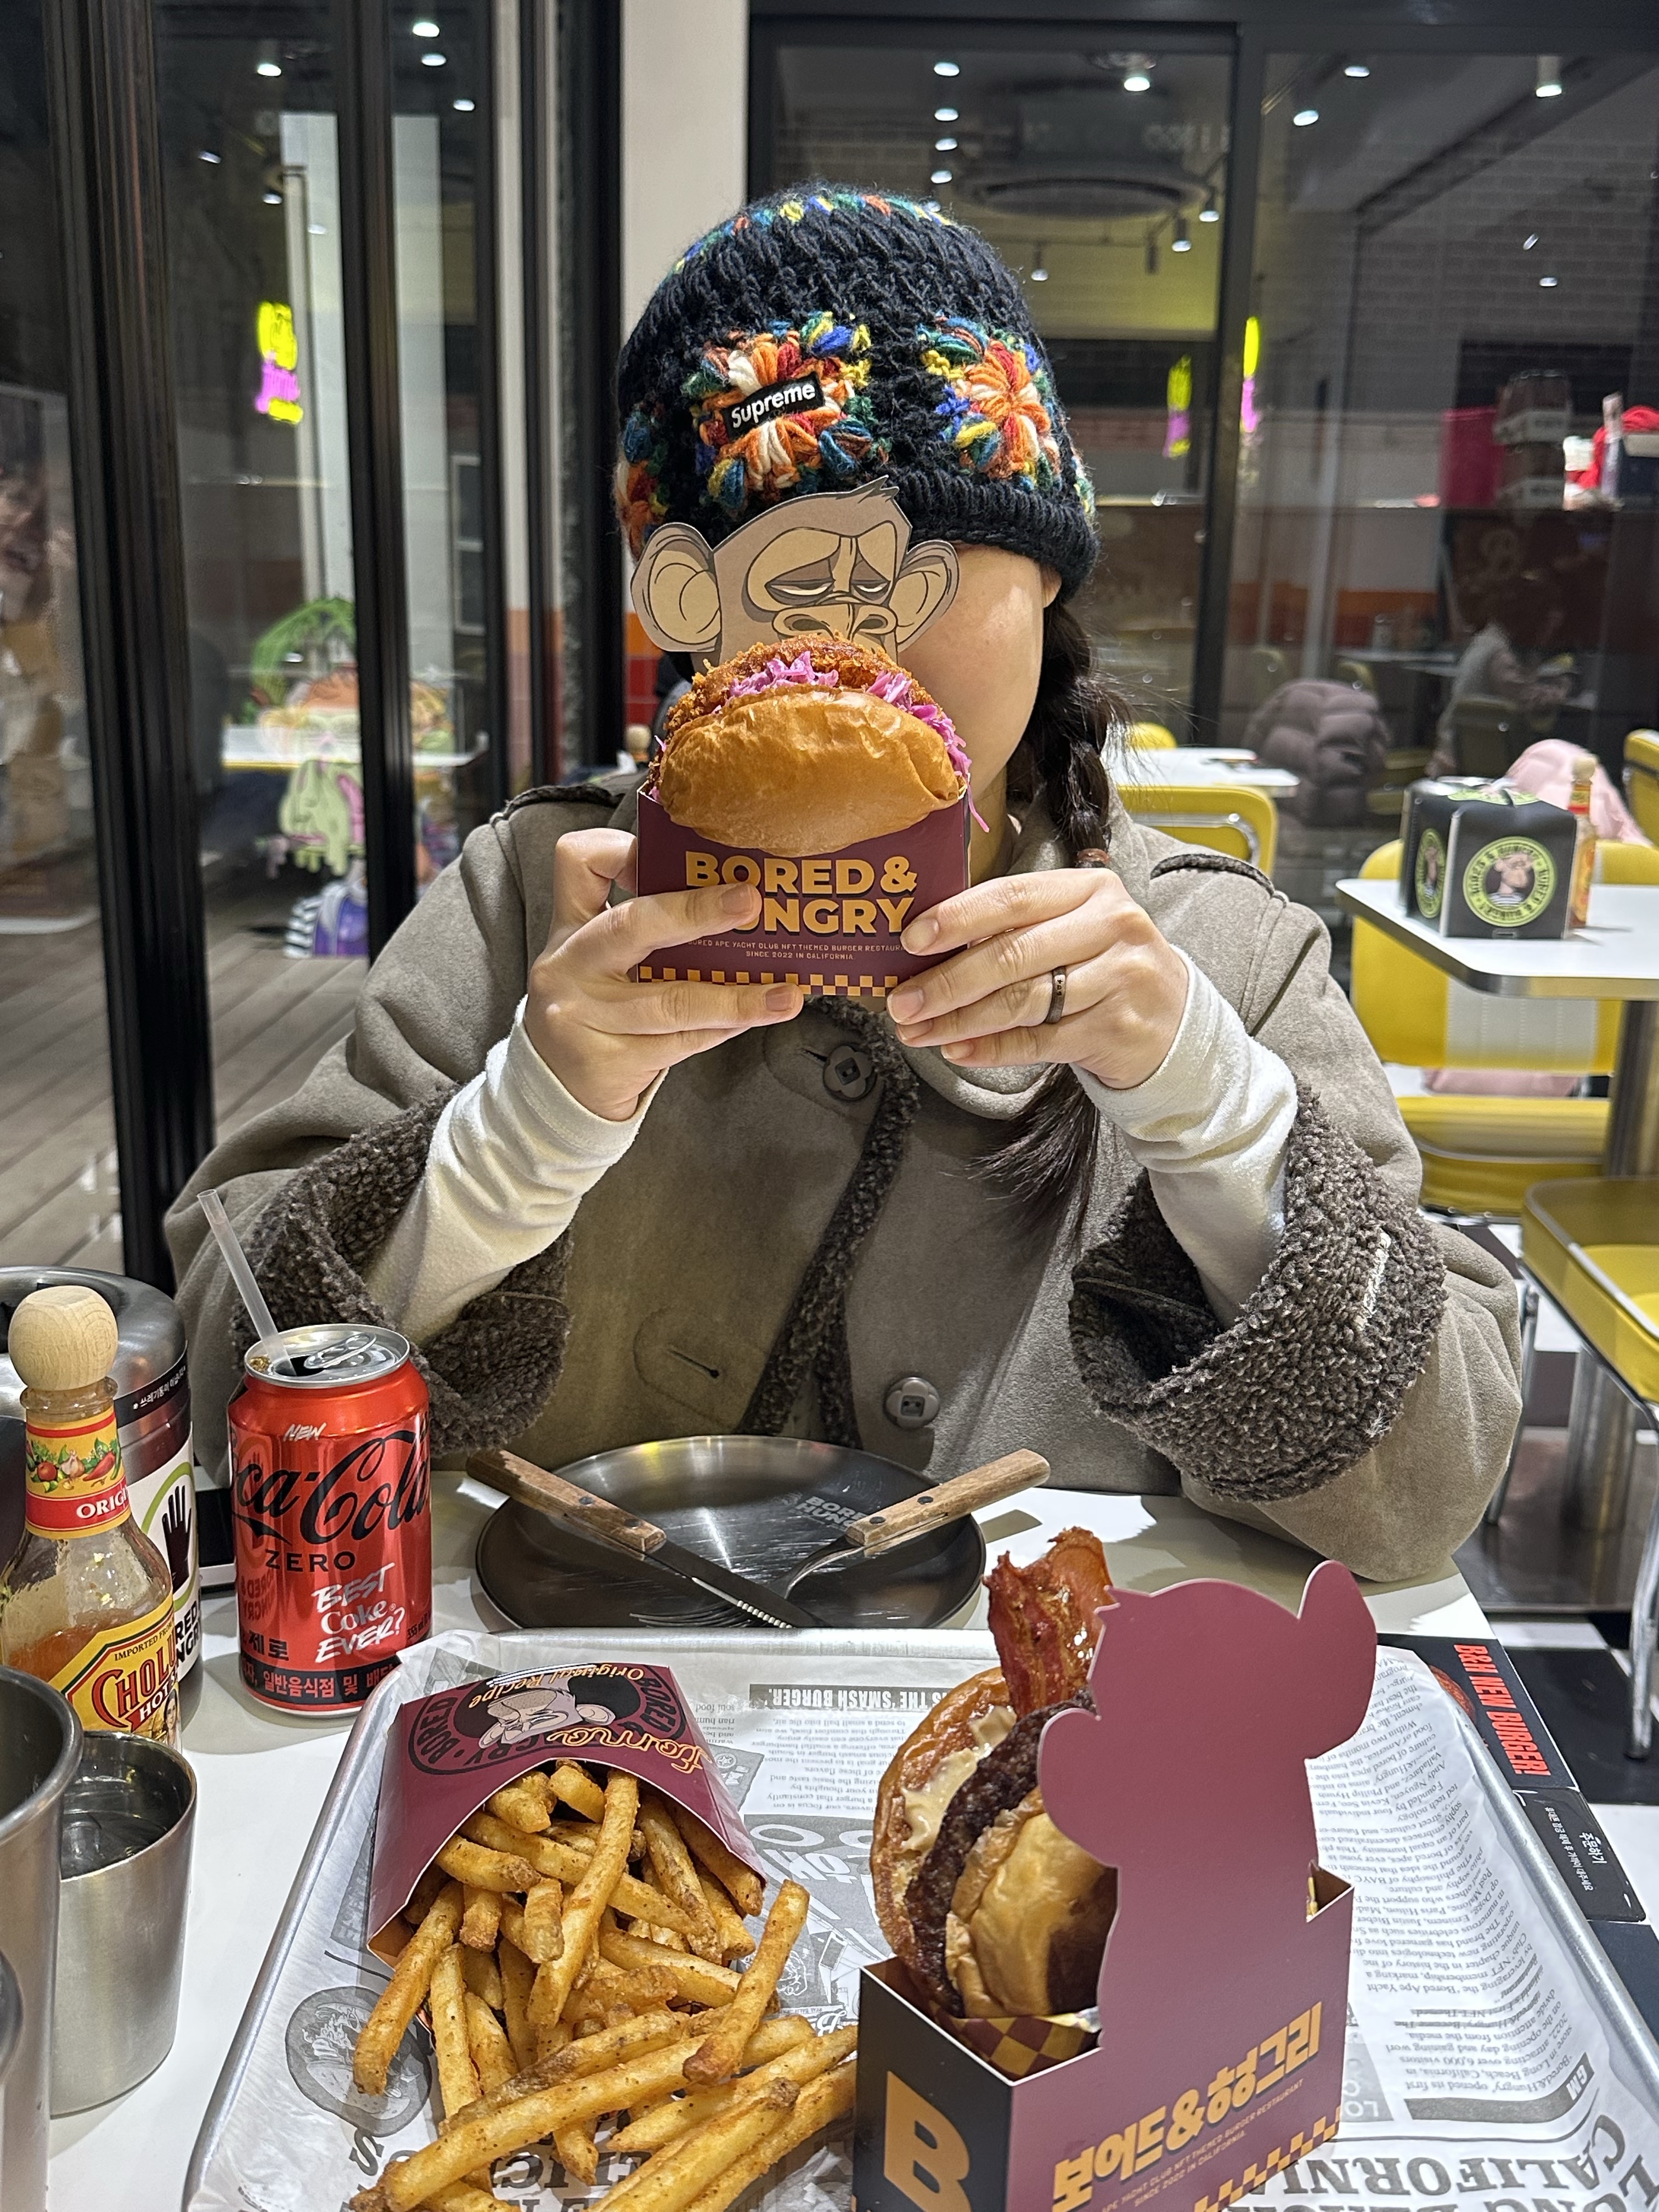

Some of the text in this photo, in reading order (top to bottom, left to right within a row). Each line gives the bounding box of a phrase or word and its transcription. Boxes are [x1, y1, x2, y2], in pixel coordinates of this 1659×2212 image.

[730, 383, 816, 428] Supreme
[685, 851, 918, 895] BORED &
[734, 897, 915, 934] NGRY
[283, 1422, 326, 1442] NEW
[265, 1549, 356, 1573] ZERO
[311, 1562, 396, 1613] BEST
[176, 1600, 198, 1644] RED
[320, 1600, 387, 1635] Coke
[114, 1635, 158, 1662] IMPORTED
[315, 1606, 405, 1663] EVER?
[263, 1670, 335, 1699] 일반음식점
[342, 1673, 359, 1697] 및
[468, 1677, 542, 1709] Recipe
[139, 1681, 169, 1723] HOT
[633, 1677, 678, 1727] BORED
[900, 1690, 928, 1709] THE
[1454, 1644, 1551, 1776] B&H NEW BURGER!
[415, 1696, 460, 1764] BORED
[1370, 1734, 1388, 1746] two
[1408, 1733, 1436, 1753] culture
[1412, 1722, 1432, 1738] food
[1426, 1760, 1445, 1782] Andy
[1384, 1781, 1400, 1793] and
[1407, 1781, 1443, 1808] Founded
[1579, 1832, 1607, 1864] 주문하기
[1455, 1932, 1486, 1948] brand
[1366, 1984, 1398, 1993] Yacht
[1399, 1983, 1420, 1993] Ape
[1464, 2034, 1492, 2043] from
[1521, 2059, 1550, 2077] Long
[884, 2070, 971, 2212] B
[1251, 2114, 1626, 2196] CALIFORNI
